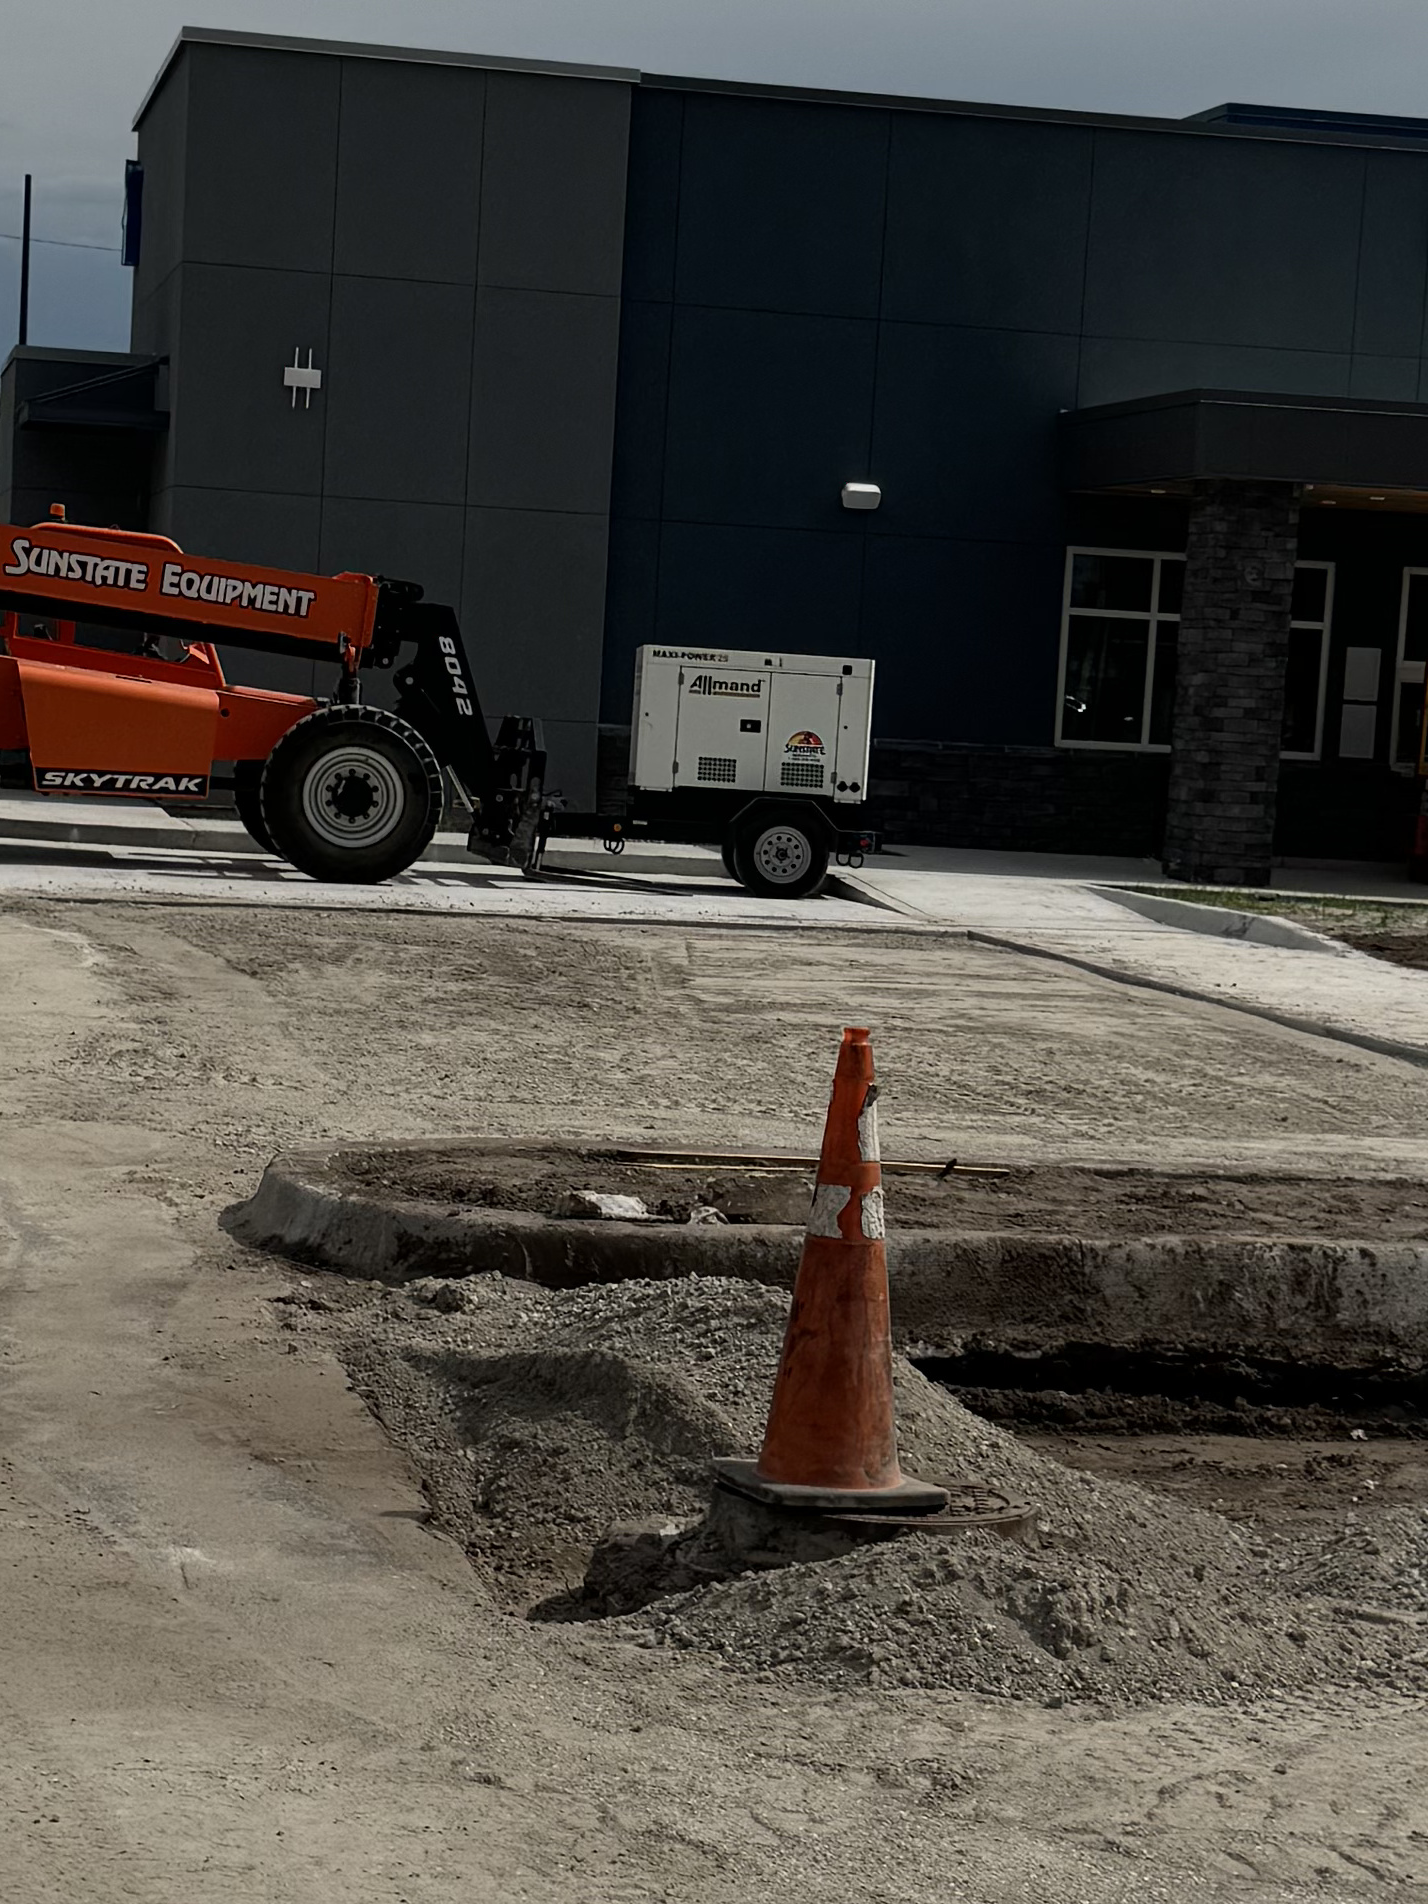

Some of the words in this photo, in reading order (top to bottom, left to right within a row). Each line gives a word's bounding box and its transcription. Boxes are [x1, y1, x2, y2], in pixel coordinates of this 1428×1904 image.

[5, 539, 148, 590] SUNSTATE
[161, 563, 315, 617] EQUIPMENT
[438, 636, 474, 716] 8042
[690, 674, 762, 696] Allmand
[41, 771, 203, 792] SKYTRAK
